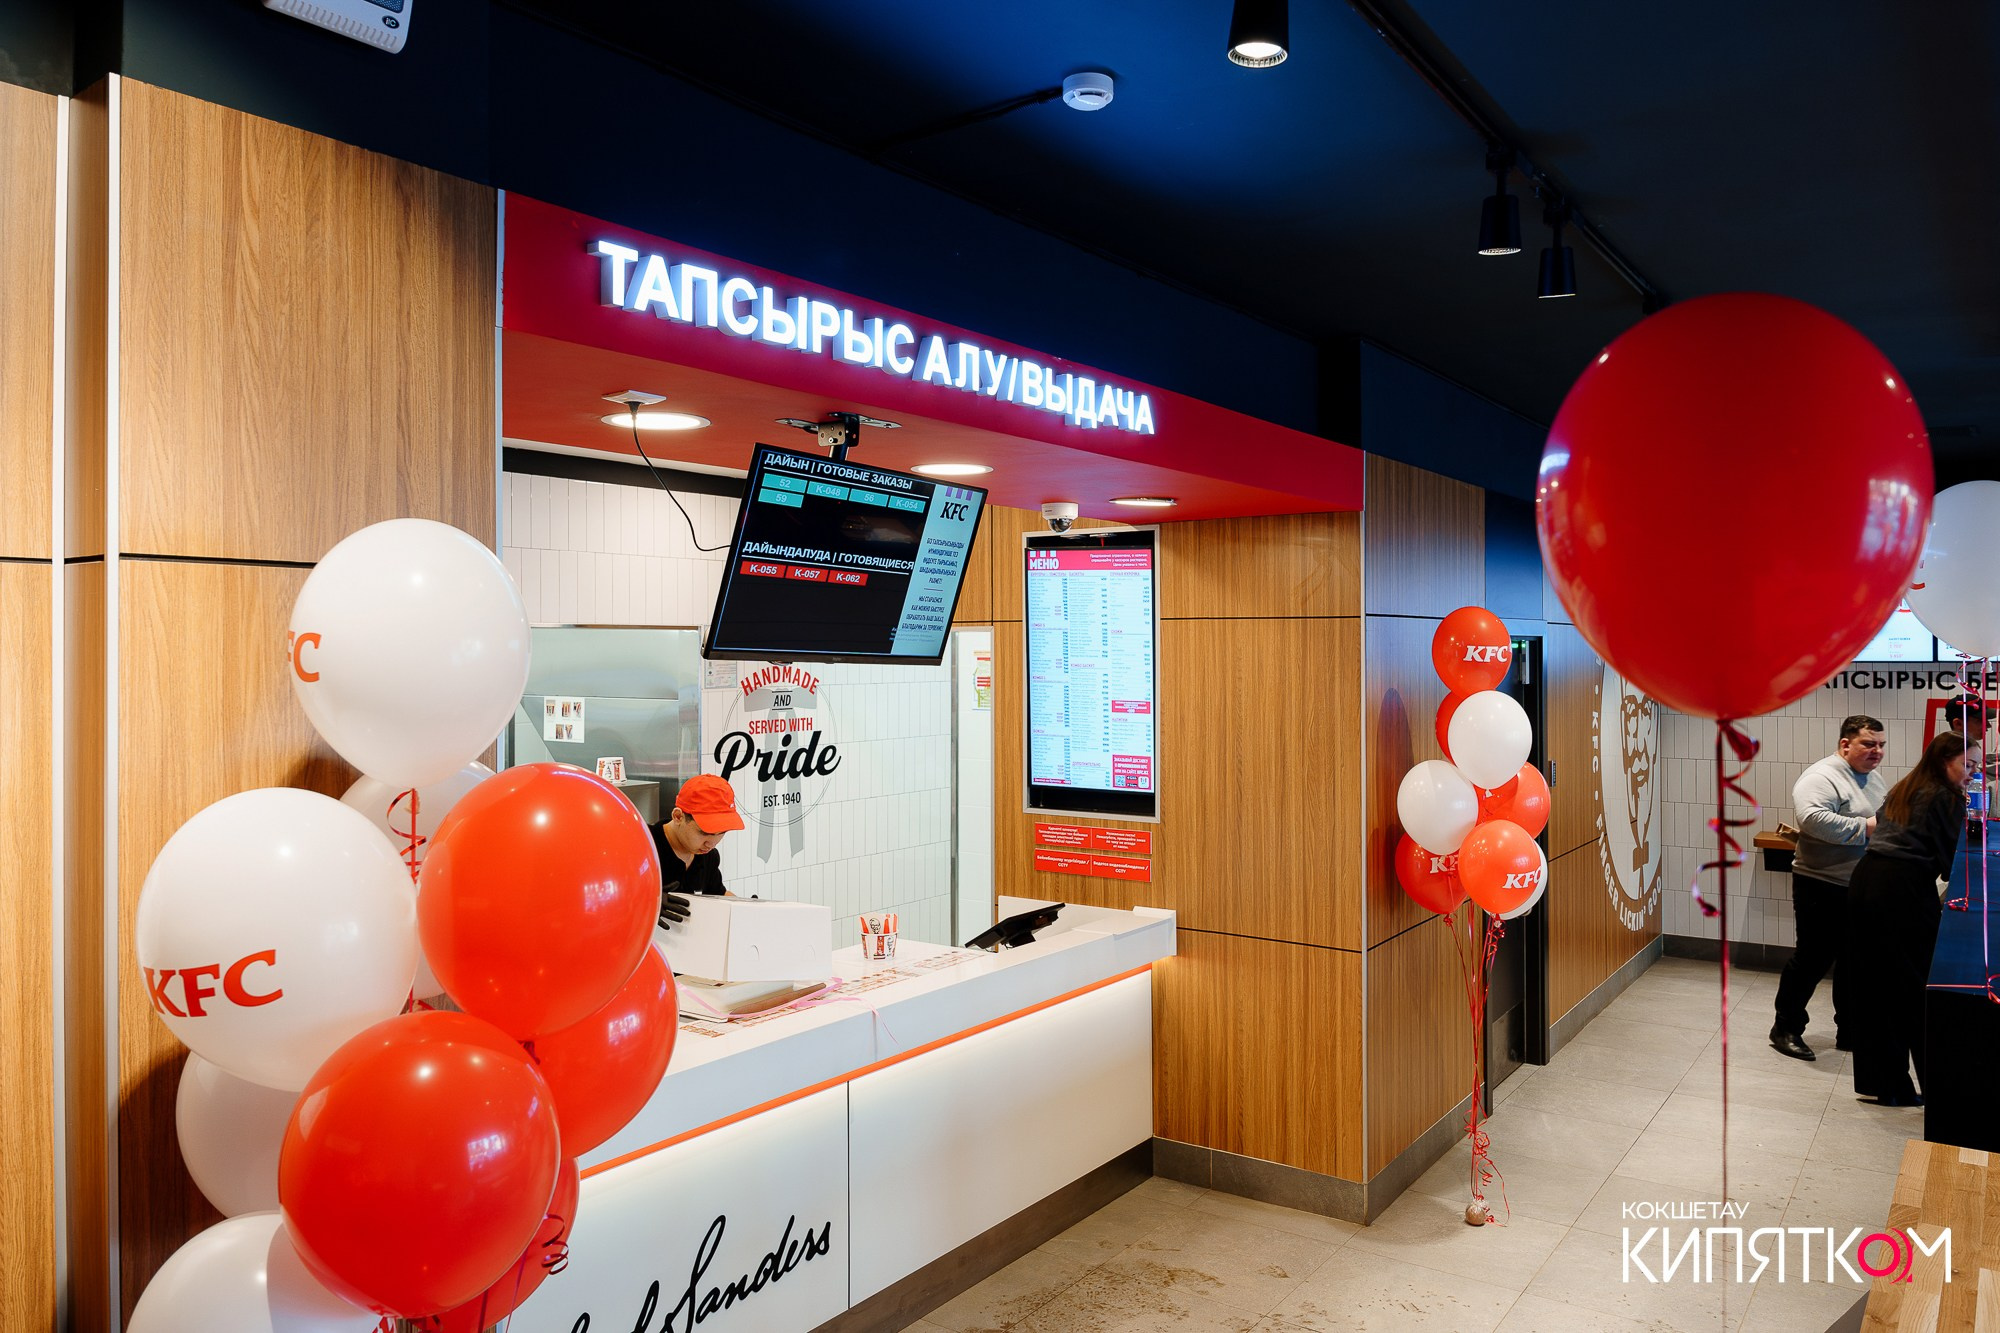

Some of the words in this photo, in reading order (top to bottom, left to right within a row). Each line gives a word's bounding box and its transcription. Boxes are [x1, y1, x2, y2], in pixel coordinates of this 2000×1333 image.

[592, 240, 915, 375] ТАПСЫРЫС
[914, 334, 1156, 435] АЛУ/ВЫДАЧА
[764, 453, 809, 471] ДАЙЫН
[817, 462, 870, 481] ГОТОВЫЕ
[871, 473, 913, 490] ЗАКАЗЫ
[779, 478, 791, 489] 52
[775, 493, 788, 503] 59
[940, 501, 969, 522] KFC
[742, 541, 830, 561] ДАЙЫНДАЛУДА
[838, 553, 915, 570] ГОТОВЯЩИЕСЯ
[1029, 558, 1059, 570] МЕНЮ
[1463, 645, 1508, 663] KFC
[740, 665, 820, 697] HANDMADE
[1823, 670, 1956, 690] ПСЫРЫС
[773, 694, 792, 707] AND
[748, 718, 786, 735] SERVED
[789, 717, 813, 731] WITH
[713, 730, 842, 783] Pride
[763, 794, 780, 808] EST.
[782, 792, 801, 805] 1940
[1596, 813, 1620, 911] FINGER
[1647, 875, 1662, 916] GOO
[1502, 866, 1542, 889] KFC
[143, 949, 283, 1018] KFC
